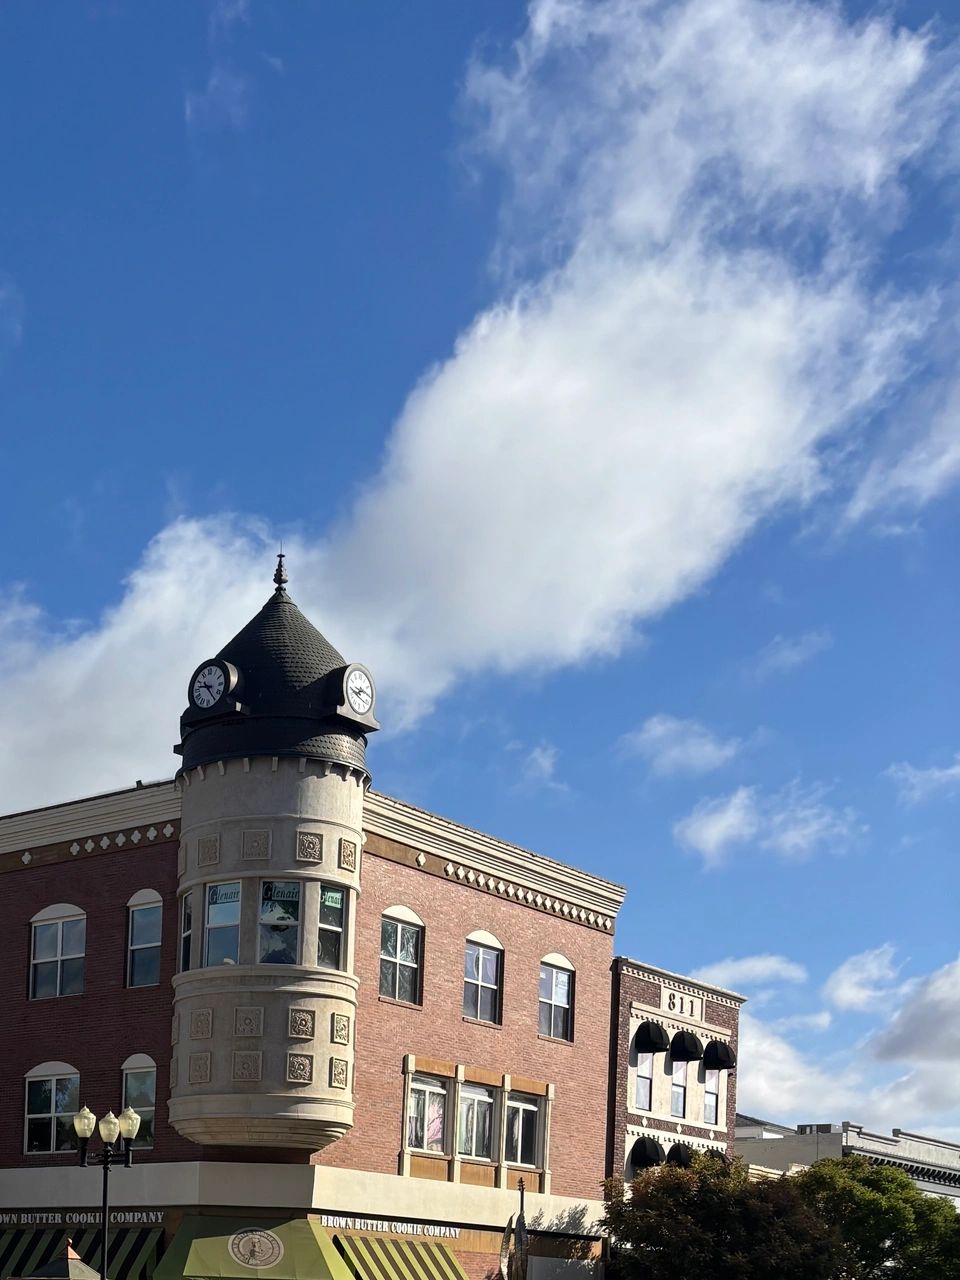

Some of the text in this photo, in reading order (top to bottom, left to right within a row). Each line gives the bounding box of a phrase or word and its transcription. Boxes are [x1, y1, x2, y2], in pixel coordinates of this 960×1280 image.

[668, 993, 695, 1017] 811
[21, 1213, 62, 1224] BUTTER
[110, 1211, 164, 1223] COMPANY
[320, 1216, 461, 1238] BROWN BUTTER COOKIE COMPANY
